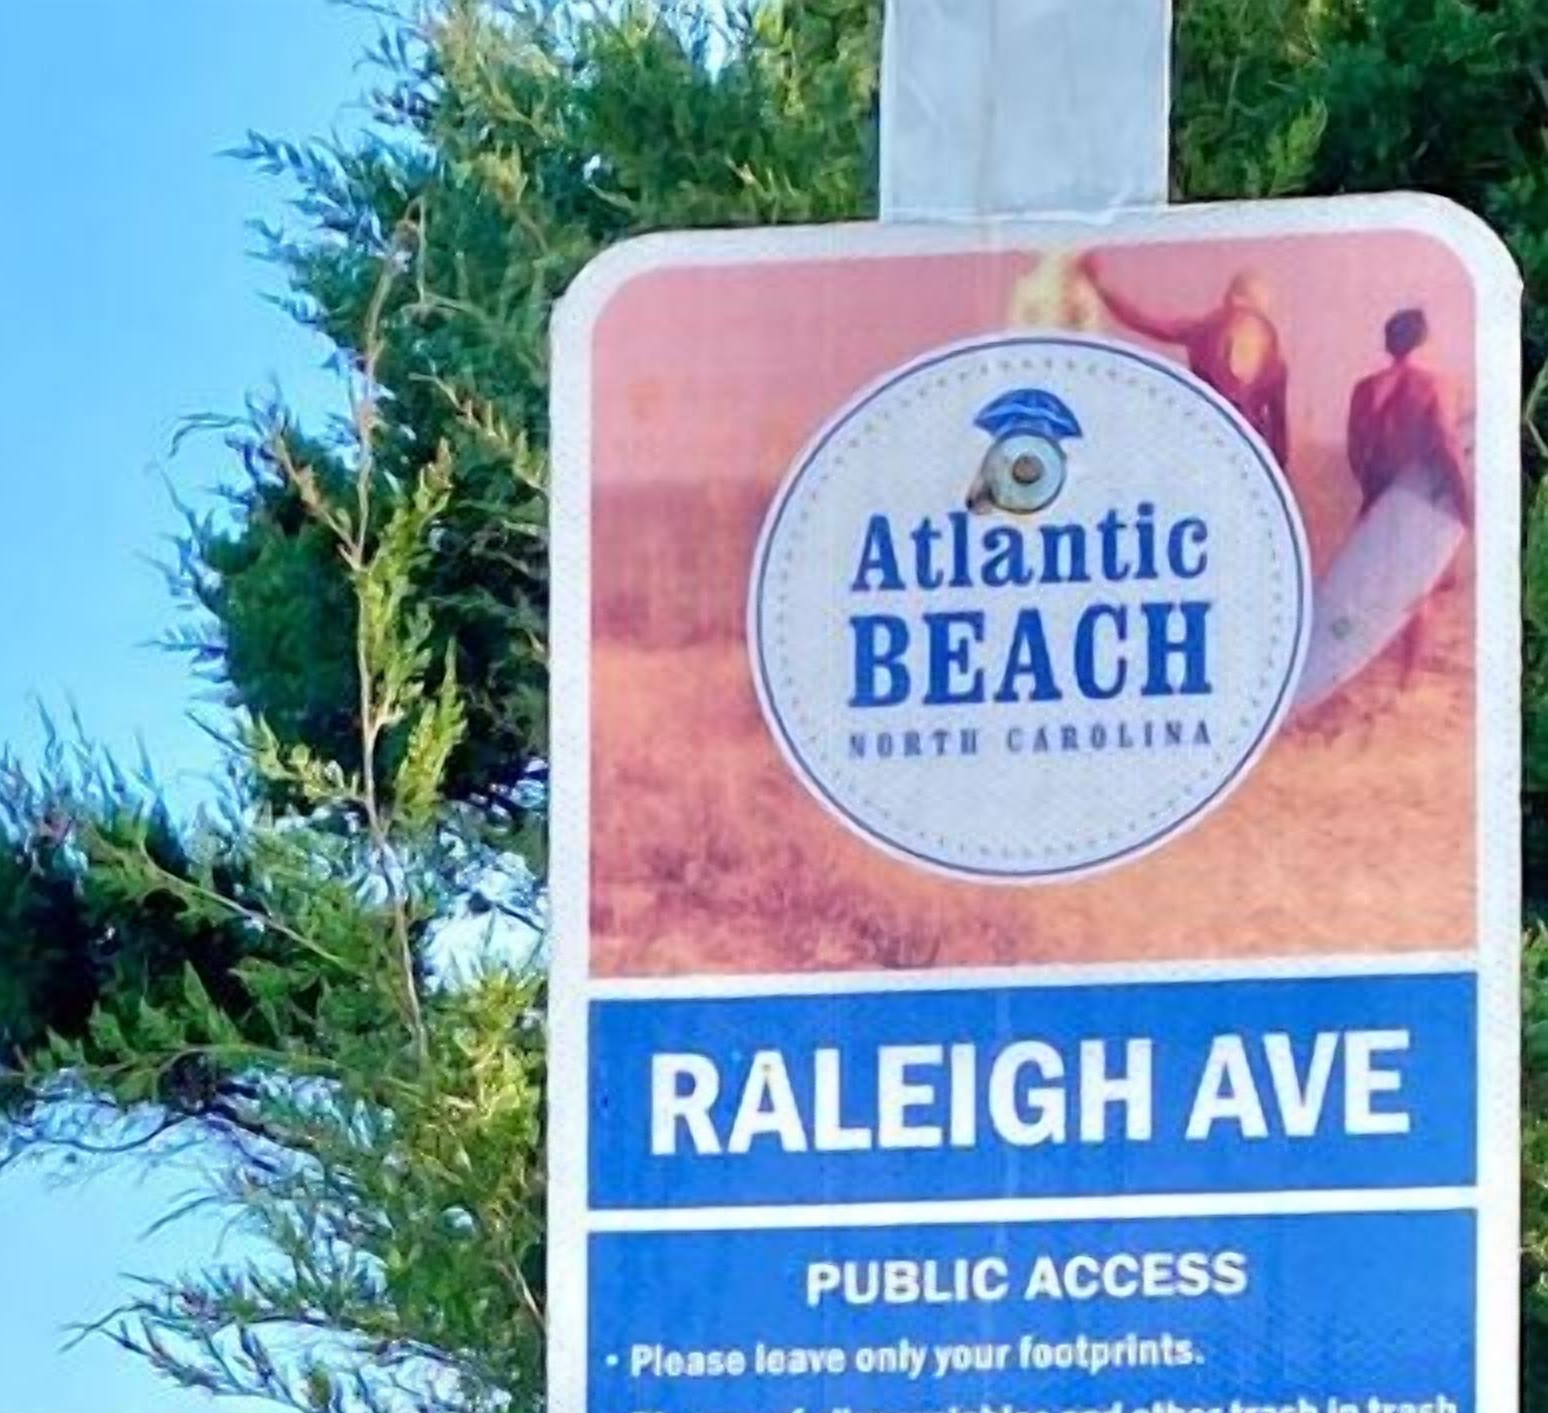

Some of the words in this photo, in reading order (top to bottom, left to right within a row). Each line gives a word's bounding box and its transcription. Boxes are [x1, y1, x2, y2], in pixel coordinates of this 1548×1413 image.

[852, 501, 1207, 591] Atlantic
[849, 601, 1212, 707] BEACH
[849, 728, 979, 758] NORTH
[1006, 720, 1210, 752] CAROLINA
[652, 1039, 1151, 1154] RALEIGH
[1186, 1030, 1409, 1138] AVE
[807, 1258, 1008, 1305] PUBLIC
[1025, 1252, 1246, 1299] ACCESS
[631, 1344, 746, 1376] Please
[755, 1343, 846, 1375] leave
[854, 1339, 927, 1379] only
[934, 1343, 1011, 1377] your
[1019, 1333, 1203, 1374] footprints.
